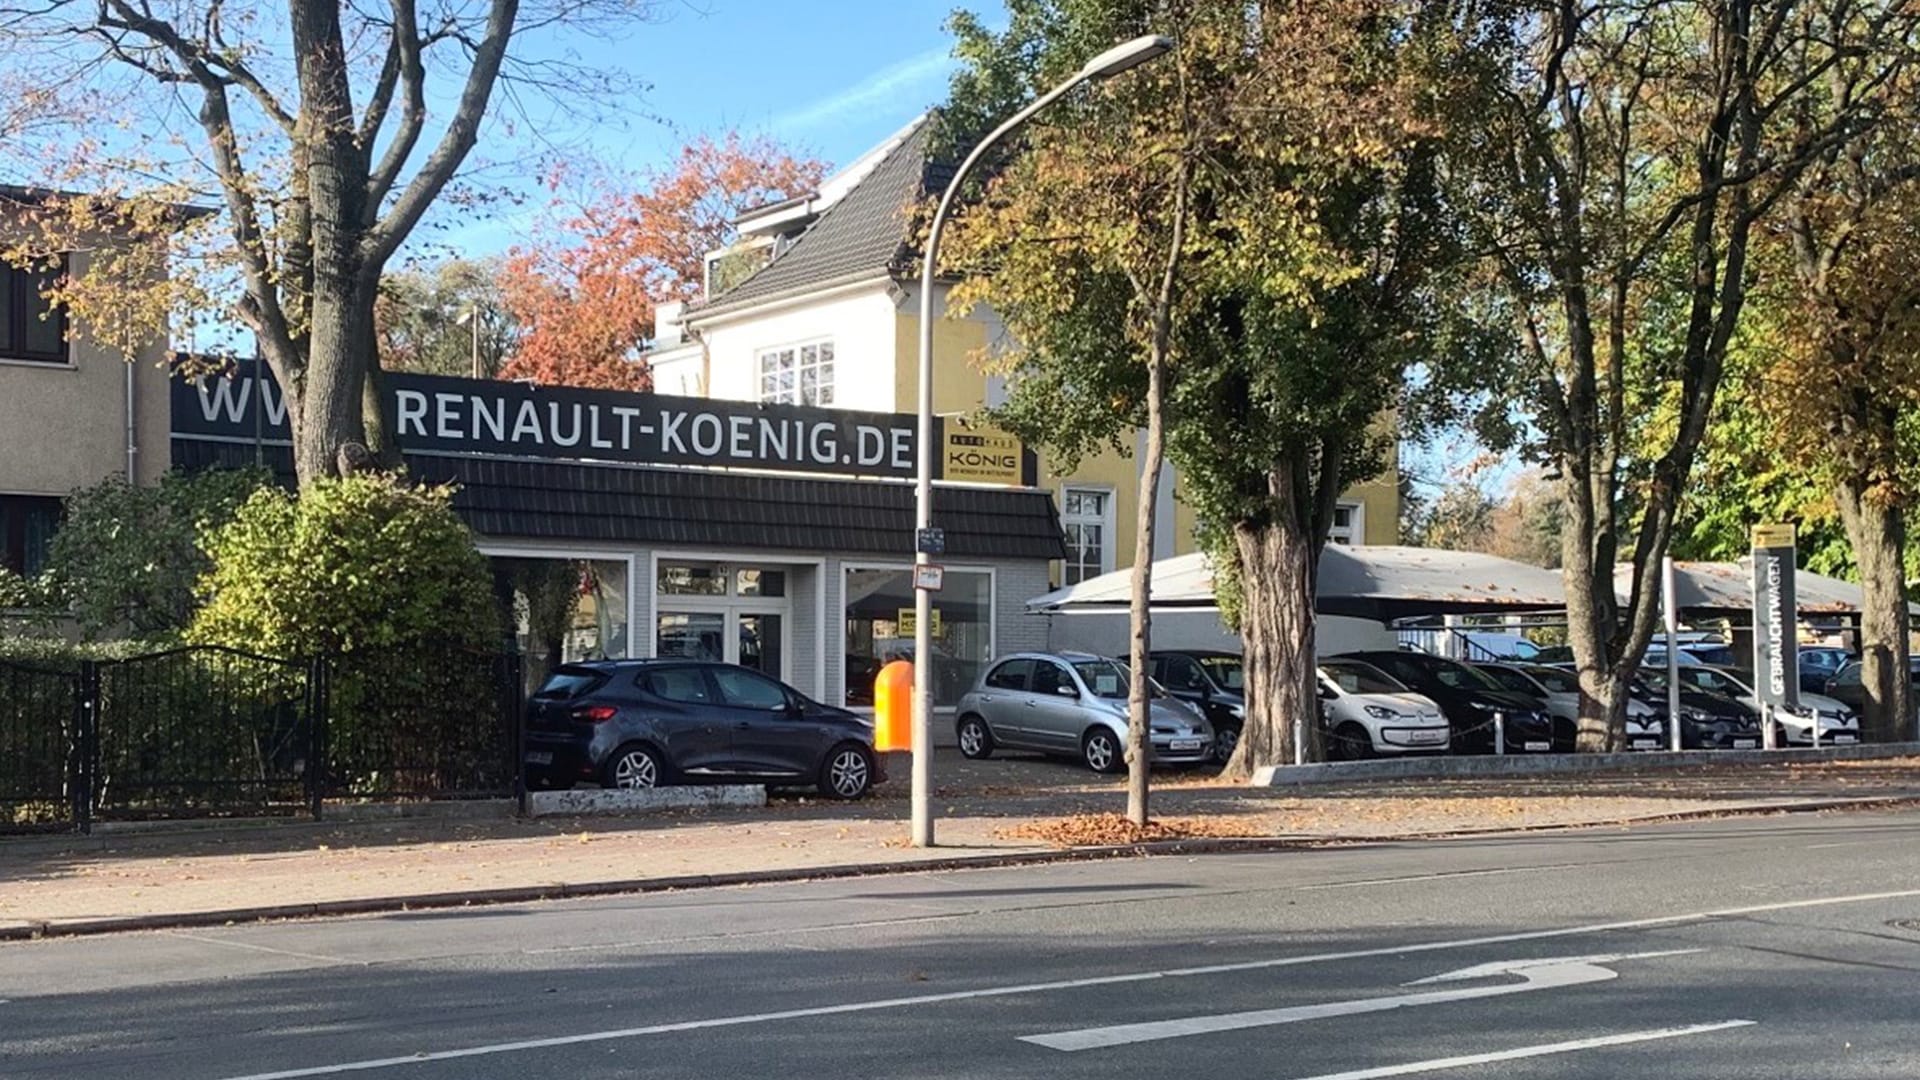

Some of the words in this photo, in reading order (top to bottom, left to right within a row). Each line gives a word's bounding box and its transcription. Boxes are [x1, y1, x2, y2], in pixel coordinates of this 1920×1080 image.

[196, 374, 912, 468] WRENAULT-KOENIG.DE
[950, 449, 1016, 468] KÖNIG
[1768, 556, 1784, 695] GEBRAUCHTWAGEN
